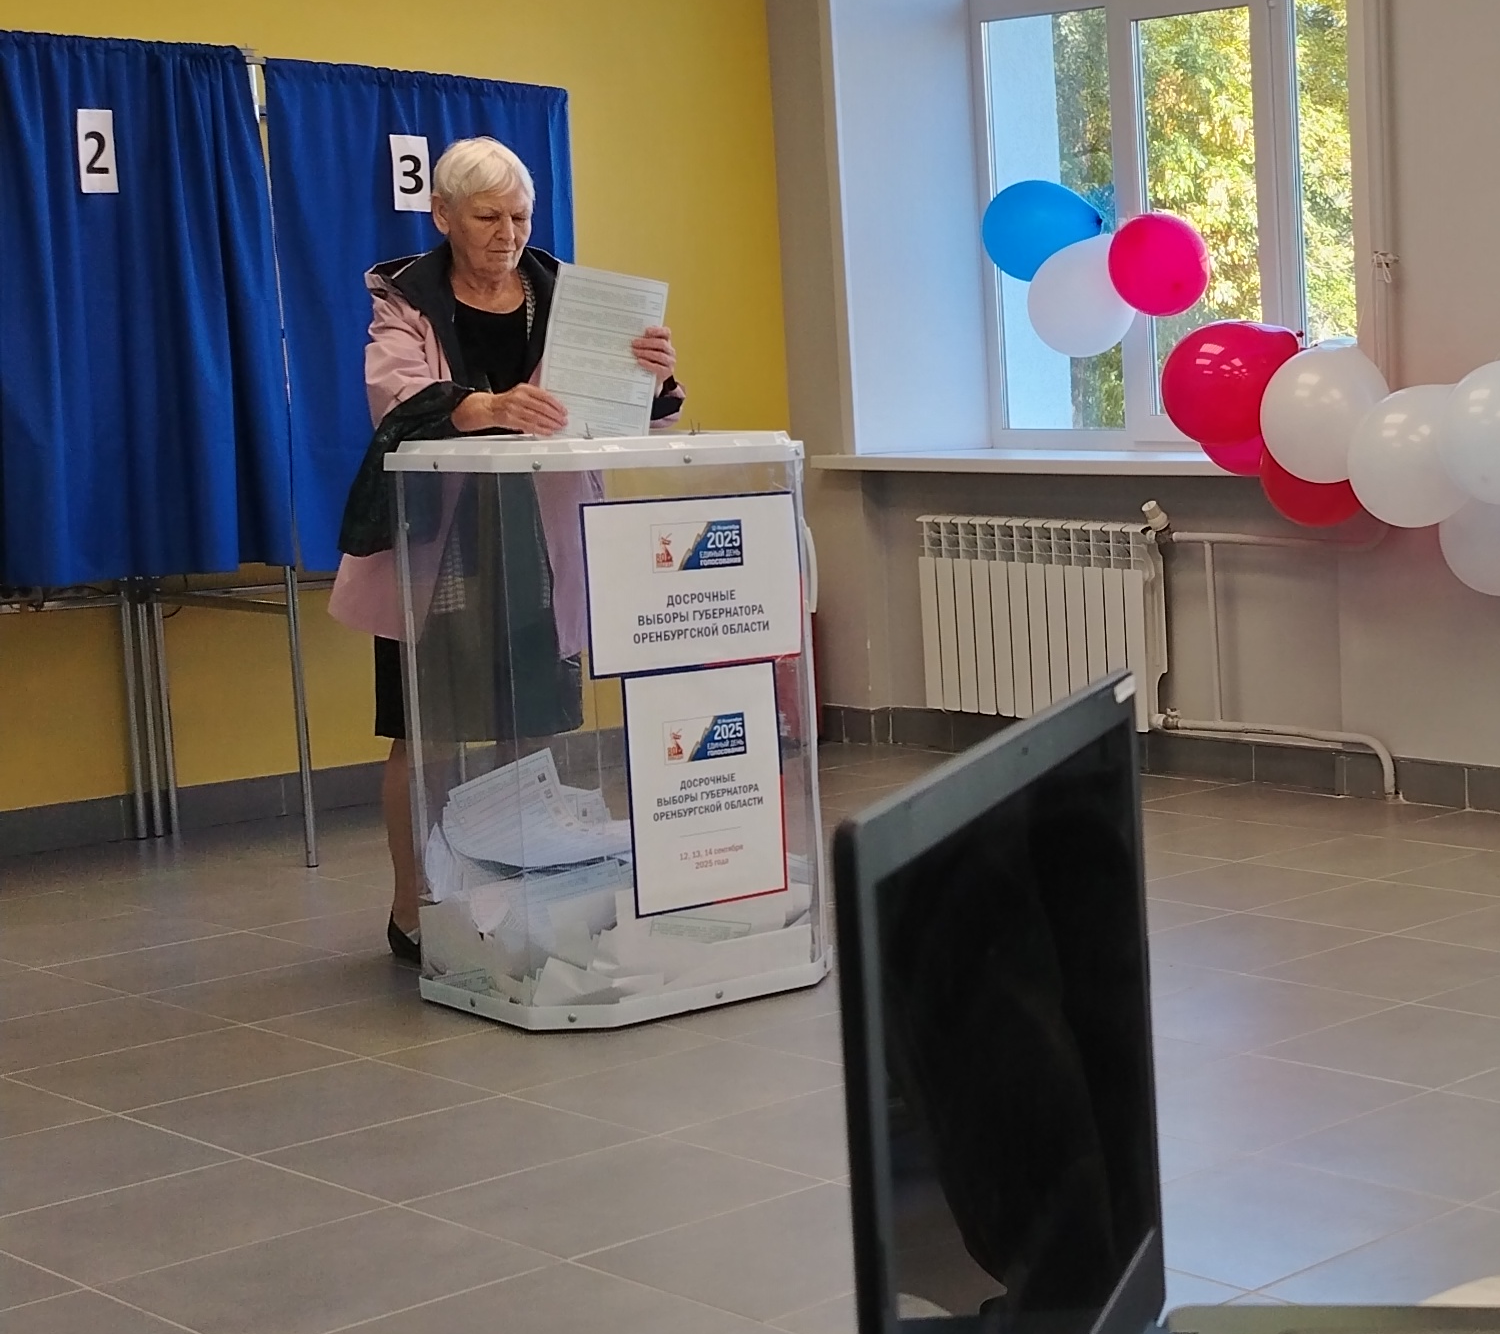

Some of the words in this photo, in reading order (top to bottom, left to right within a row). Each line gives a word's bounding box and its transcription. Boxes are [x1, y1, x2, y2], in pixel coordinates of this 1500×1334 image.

[84, 130, 110, 175] 2
[398, 154, 424, 195] 3
[706, 530, 741, 549] 2025
[666, 589, 737, 608] ДОСРОЧНЫЕ
[637, 611, 690, 627] ВЫБОРЫ
[692, 603, 765, 621] ГУБЕРНАТОРА
[633, 623, 719, 645] ОРЕНБУРГСКОЙ
[721, 620, 770, 636] ОБЛАСТИ
[713, 722, 744, 741] 2025
[679, 772, 736, 791] ДОСРОЧНЫЕ
[656, 792, 699, 808] ВЫБОРЫ
[700, 783, 760, 801] ГУБЕРНАТОРА
[652, 801, 722, 822] ОРЕНБУРГСКОЙ
[723, 796, 765, 811] ОБЛАСТИ
